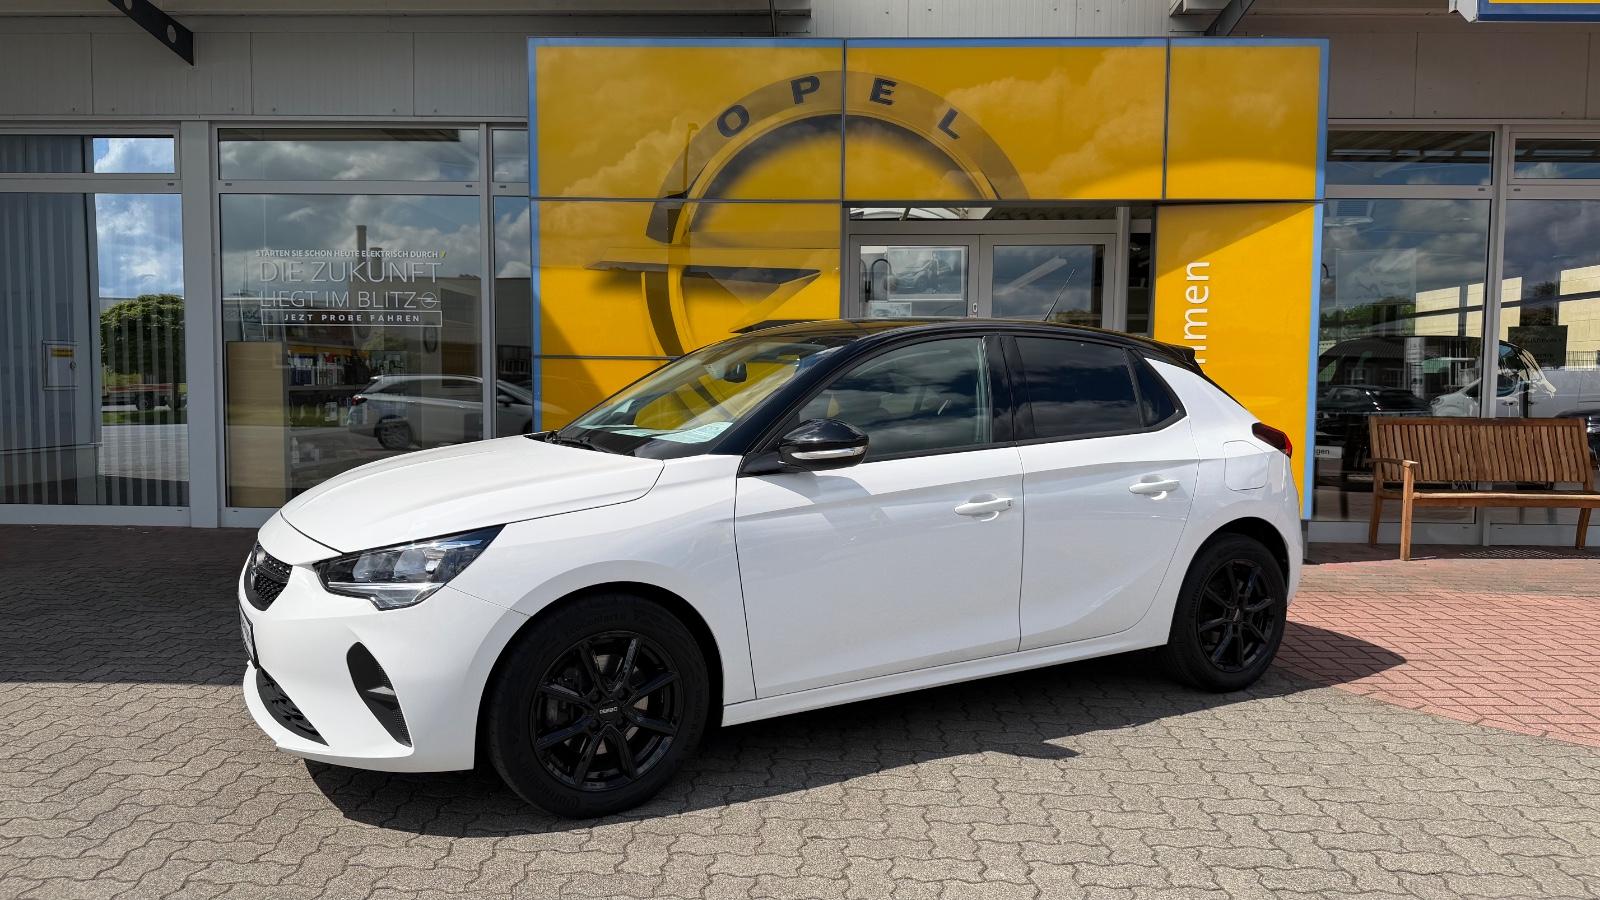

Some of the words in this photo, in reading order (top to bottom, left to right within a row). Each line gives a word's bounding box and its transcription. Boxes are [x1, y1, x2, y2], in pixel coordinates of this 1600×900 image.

[717, 75, 961, 140] OPEL
[255, 249, 290, 258] STARTEN
[292, 250, 304, 258] SIE
[305, 250, 333, 258] SCHON
[334, 250, 360, 258] HEUTE
[361, 250, 409, 259] ELEKTRISCH
[410, 251, 438, 259] DURCH
[260, 261, 303, 283] DIE
[311, 261, 441, 283] ZUKUNFT
[260, 290, 318, 307] LIEGT
[326, 291, 350, 308] IM
[358, 291, 417, 309] BLITZ
[284, 313, 313, 321] JEZT
[321, 314, 362, 322] PROBE
[370, 314, 420, 322] FAHREN
